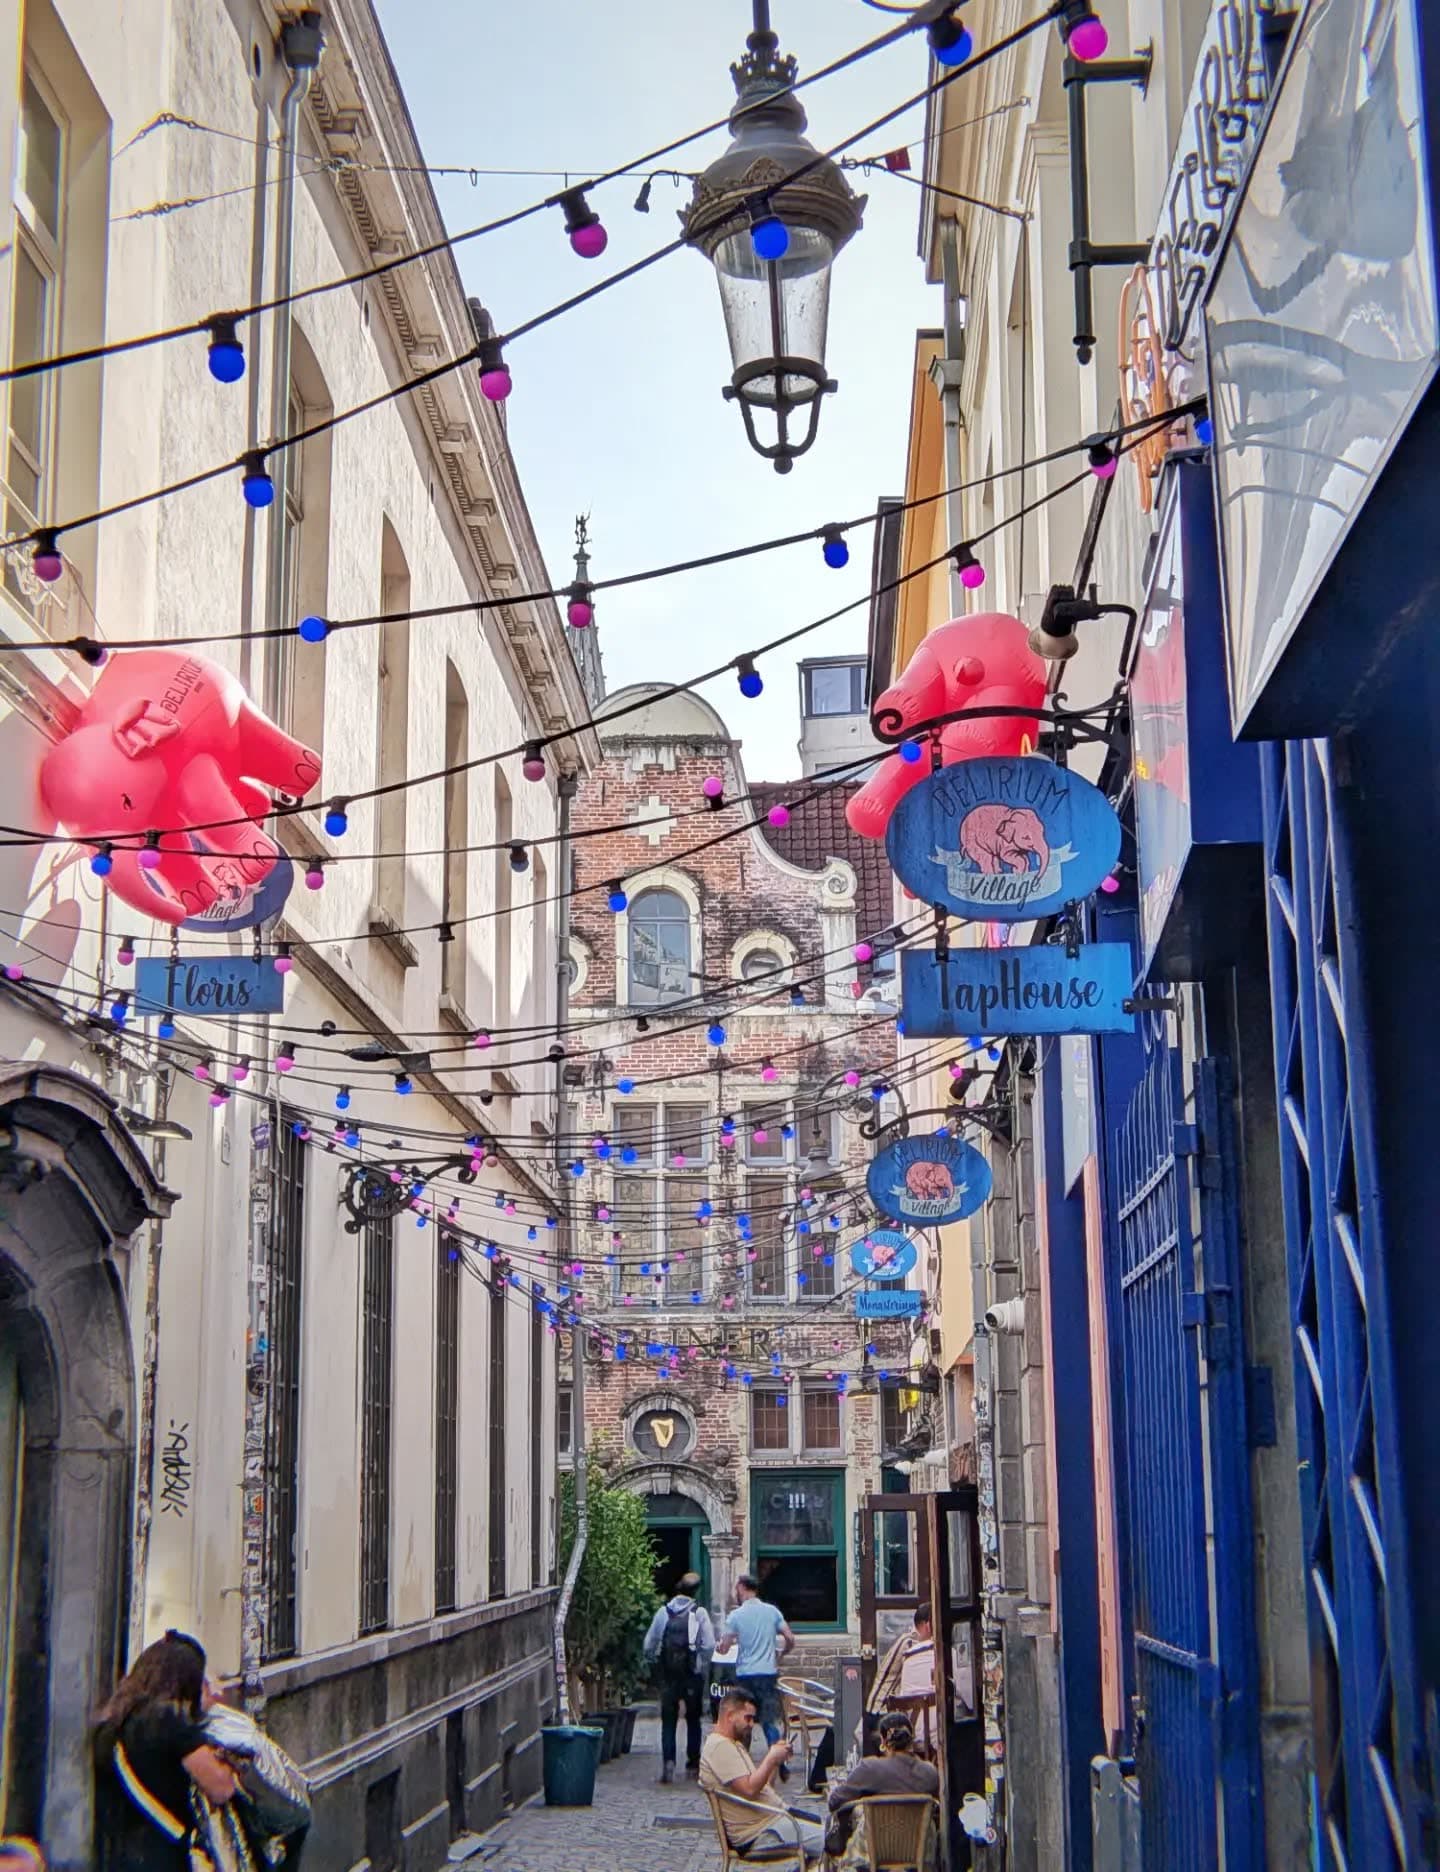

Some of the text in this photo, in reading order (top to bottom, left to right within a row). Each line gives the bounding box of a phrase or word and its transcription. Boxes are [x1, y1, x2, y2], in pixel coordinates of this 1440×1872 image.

[931, 766, 1071, 817] DELIRIUM
[969, 876, 1041, 912] Village
[164, 962, 251, 1009] Floris
[930, 957, 1103, 1028] TapHouse
